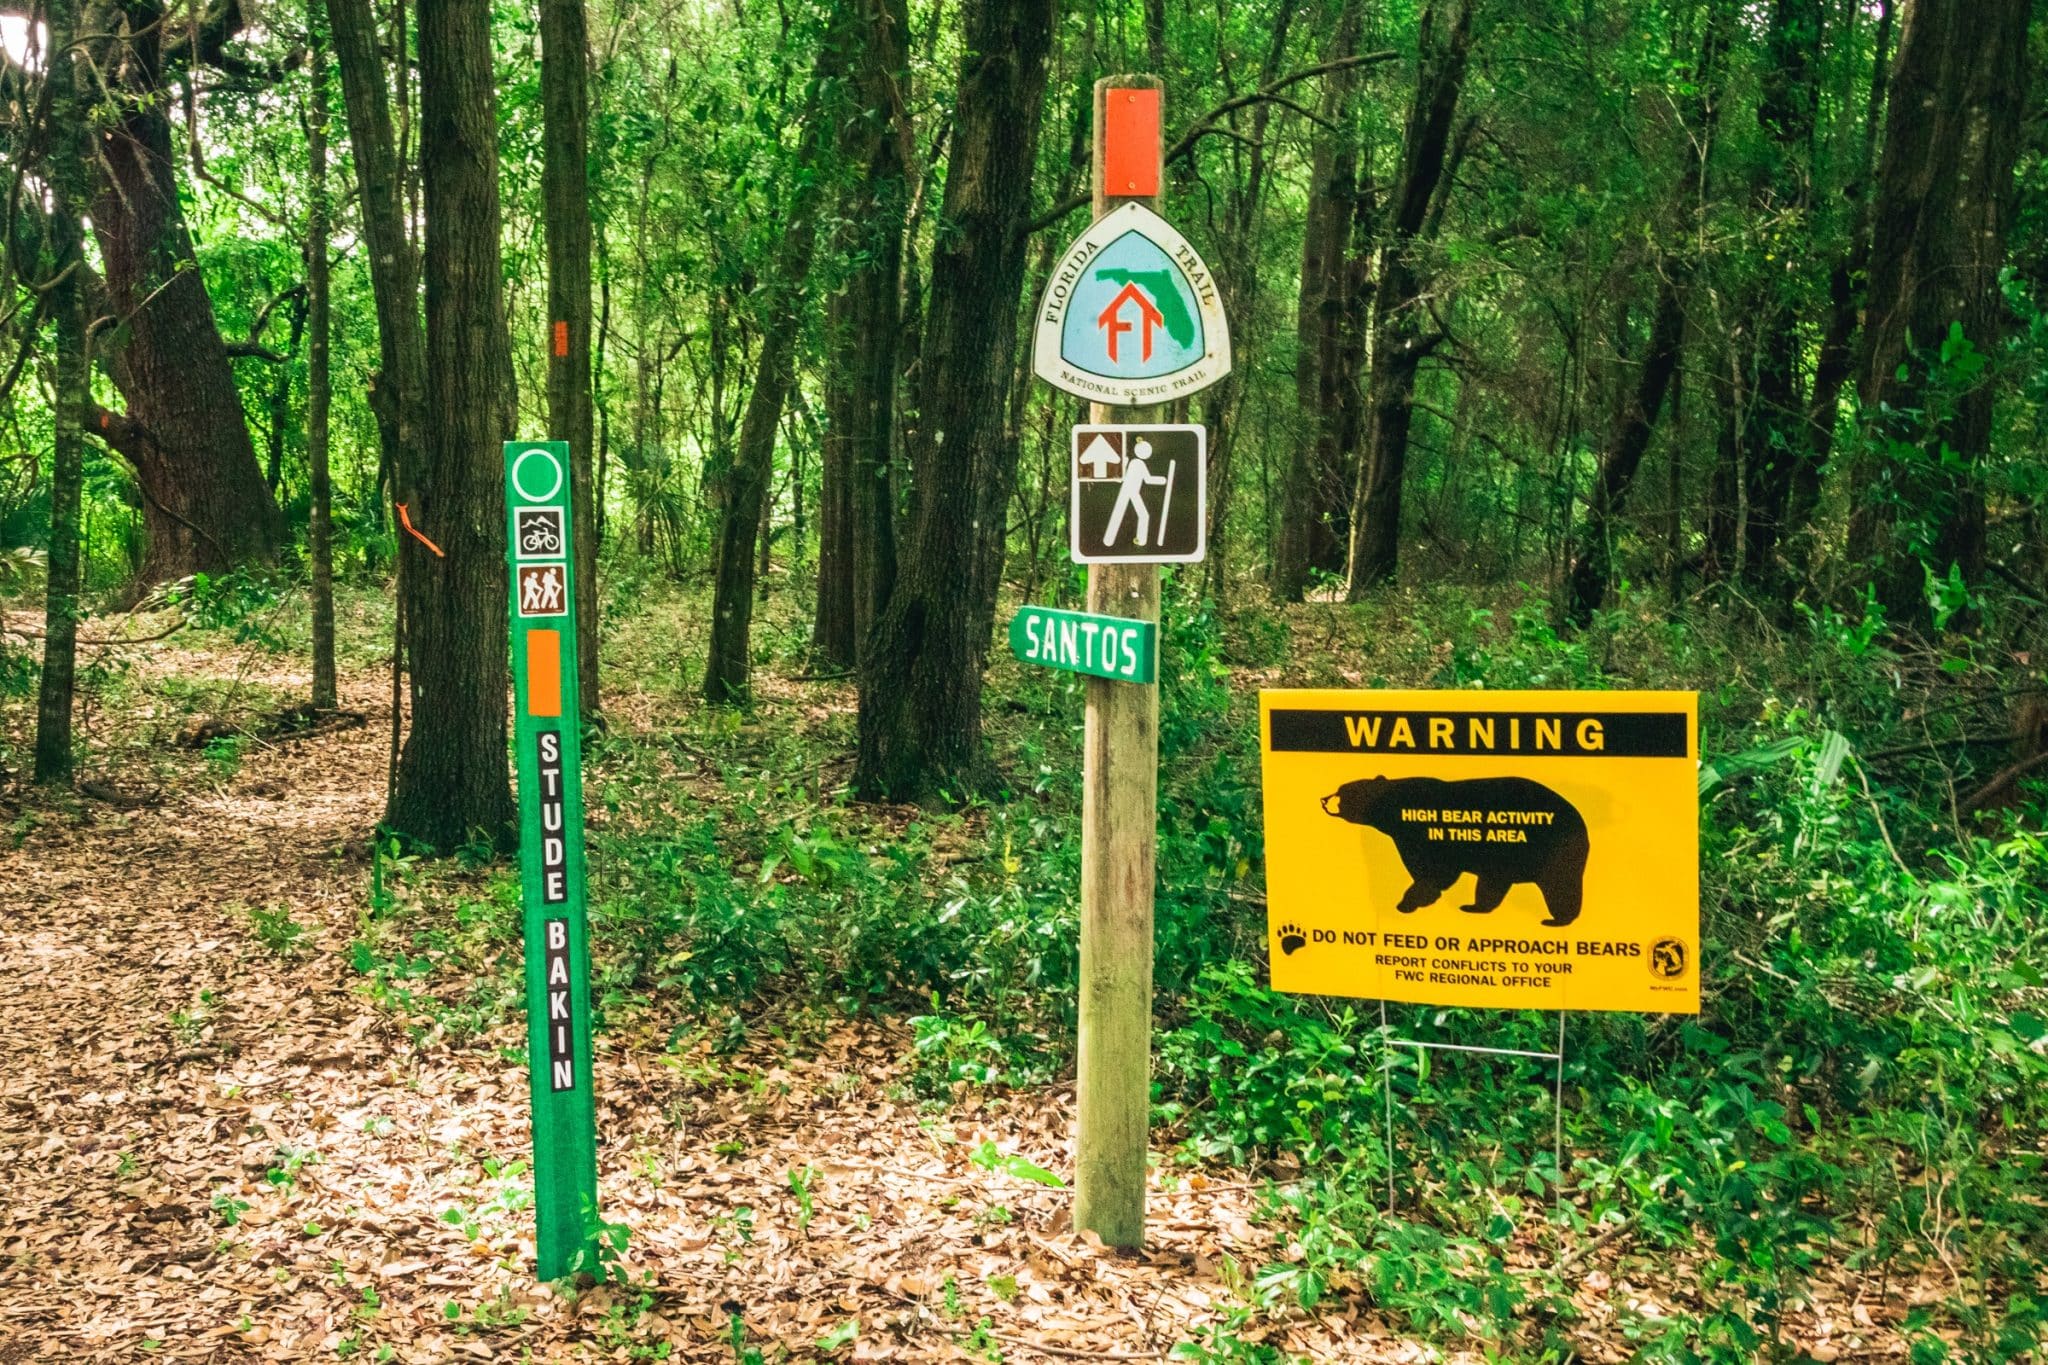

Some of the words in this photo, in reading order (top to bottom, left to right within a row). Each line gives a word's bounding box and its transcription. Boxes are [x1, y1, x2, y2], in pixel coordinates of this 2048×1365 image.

[1046, 240, 1099, 325] FLORIDA
[1175, 245, 1216, 306] TRAIL
[1060, 370, 1119, 396] NATIONAL
[1123, 386, 1168, 397] SCENIC
[1172, 370, 1206, 390] TRAIL
[1026, 614, 1138, 676] SANTOS
[1344, 716, 1606, 751] WARNING
[540, 733, 564, 900] STUDE
[1401, 808, 1437, 822] HIGH
[1442, 809, 1482, 824] BEAR
[1487, 811, 1555, 825] ACTIVITY
[1428, 827, 1444, 841] IN
[1448, 828, 1482, 842] THIS
[1486, 829, 1527, 843] AREA
[1312, 928, 1337, 944] DO
[1343, 930, 1377, 946] NOT
[1383, 933, 1428, 949] FEED
[1435, 936, 1460, 951] OR
[1467, 938, 1569, 955] APPROACH
[1576, 941, 1642, 957] BEARS
[1375, 953, 1427, 969] REPORT
[1431, 958, 1507, 973] CONFLICTS
[1511, 962, 1530, 974] TO
[1534, 962, 1573, 975] YOUR
[1395, 969, 1425, 982] FWC
[1429, 972, 1497, 987] REGIONAL
[1502, 975, 1551, 988] OFFICE
[548, 921, 573, 1089] BAKIN
